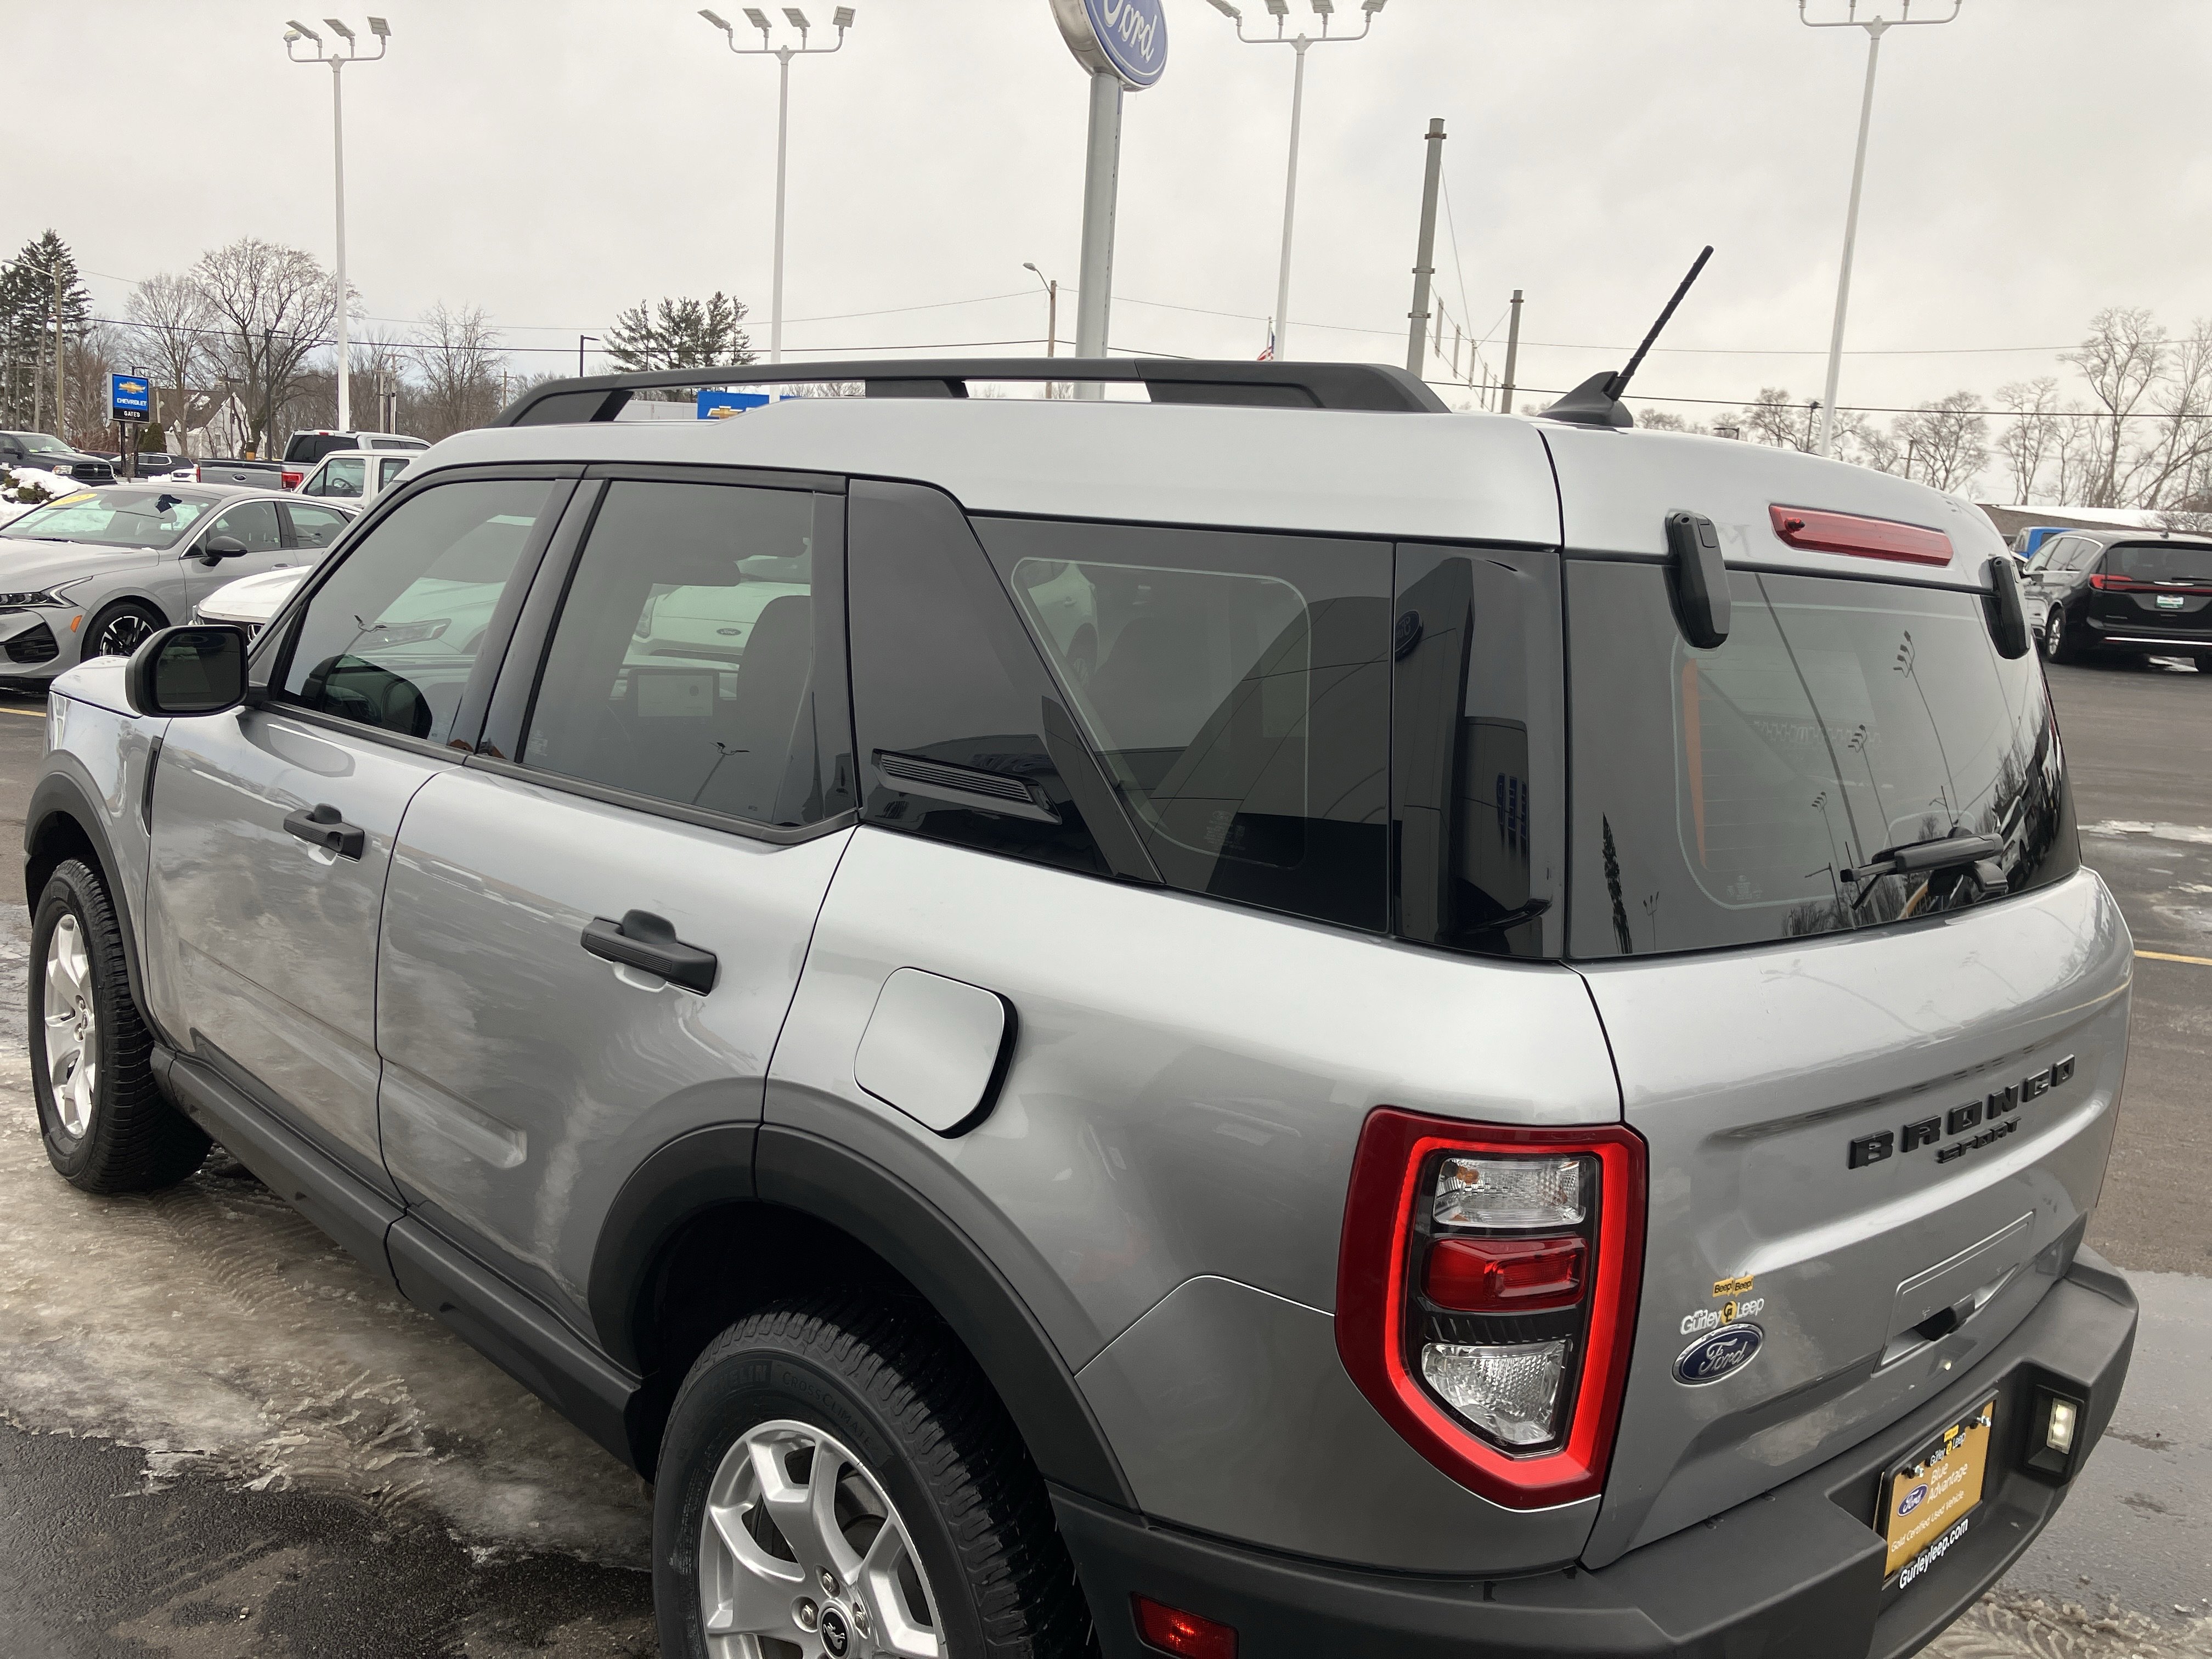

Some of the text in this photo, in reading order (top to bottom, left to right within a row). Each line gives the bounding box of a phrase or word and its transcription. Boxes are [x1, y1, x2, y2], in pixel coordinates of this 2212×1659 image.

[117, 398, 147, 407] CHEVROLET
[1848, 1054, 2075, 1170] BRONCO
[1936, 1116, 2022, 1164] SPORT
[1714, 1278, 1753, 1294] Beep! Beep!
[1680, 1310, 1722, 1335] Gurley
[1736, 1297, 1764, 1318] Leep
[1699, 1338, 1748, 1375] Ford
[1927, 1463, 1968, 1504] Advantage
[1931, 1463, 1949, 1485] Blue
[1902, 1489, 1923, 1513] Ford
[1899, 1518, 1969, 1589] Gurleyleep.com
